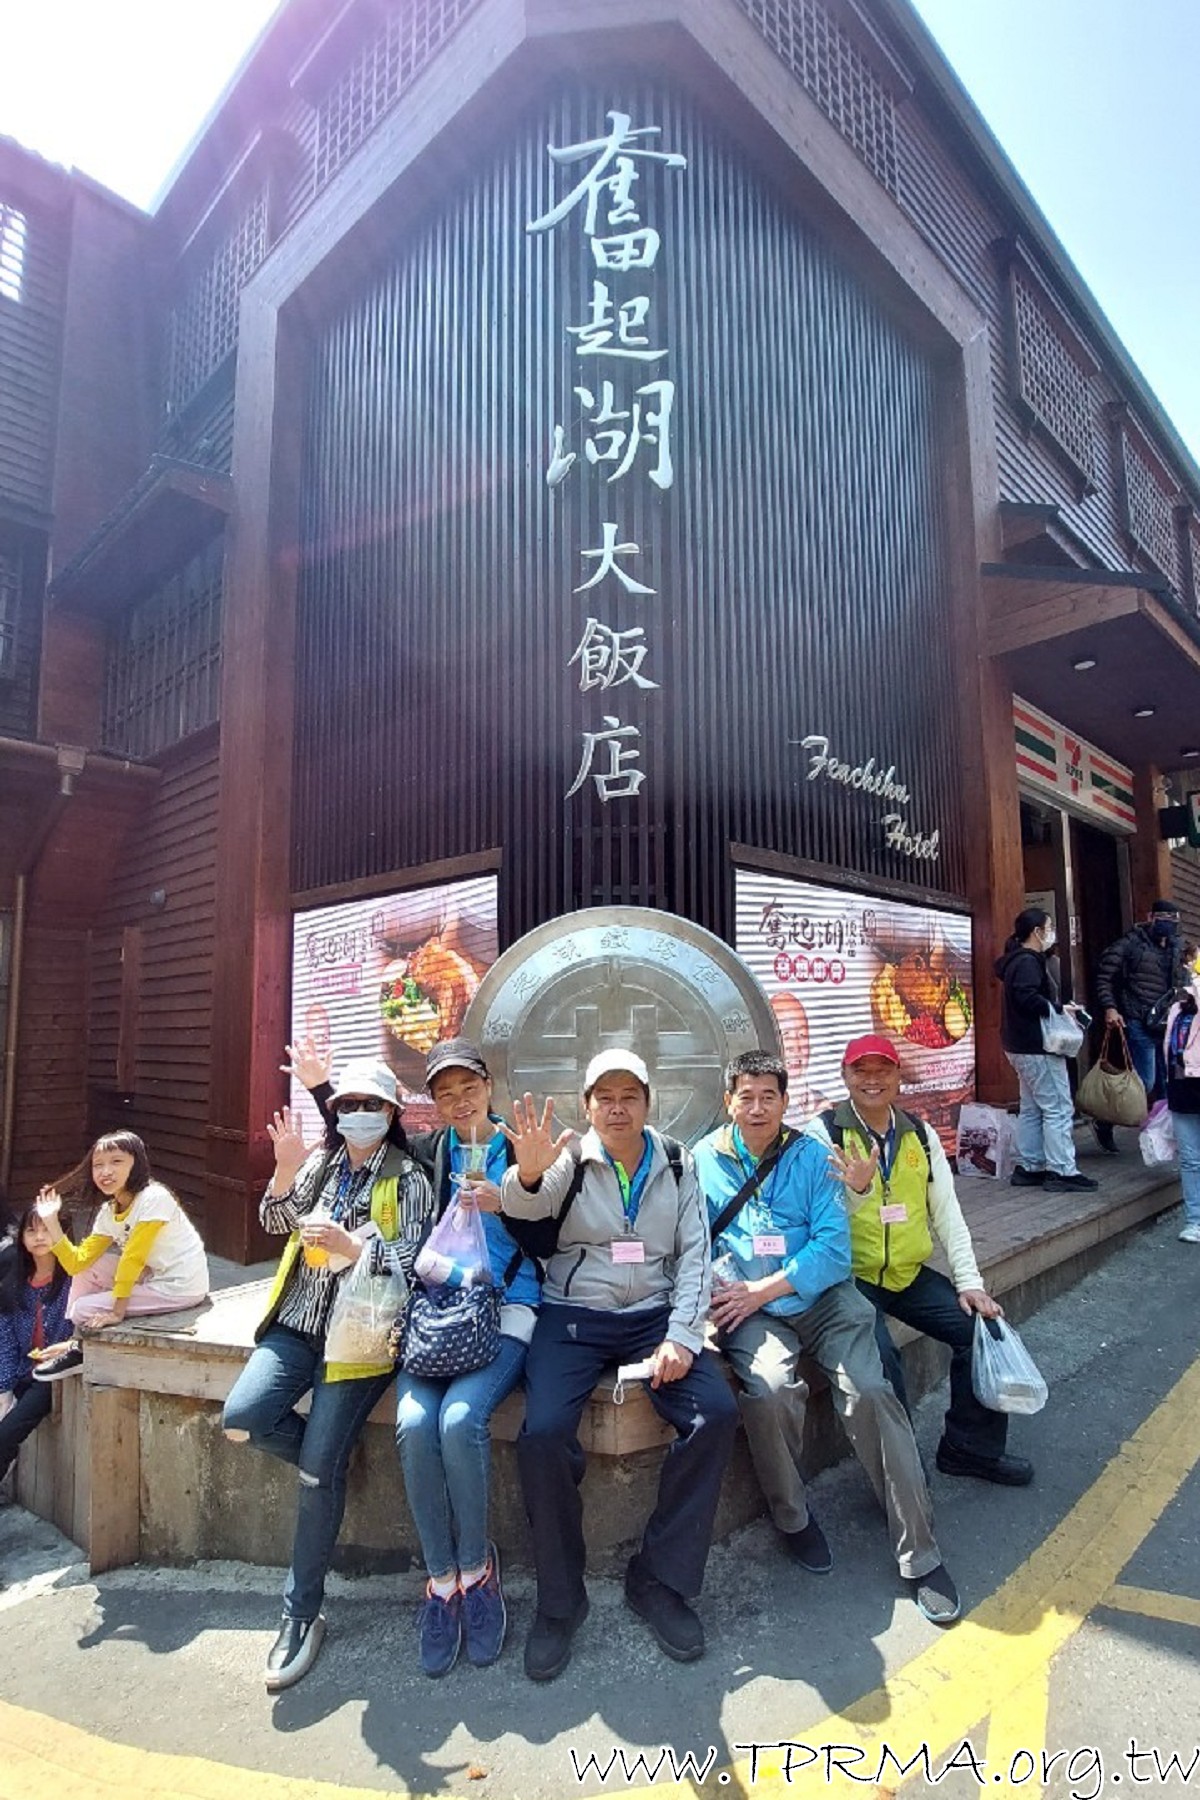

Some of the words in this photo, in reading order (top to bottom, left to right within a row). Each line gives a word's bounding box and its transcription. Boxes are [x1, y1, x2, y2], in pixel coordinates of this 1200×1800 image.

[526, 110, 687, 803] 奮起湖大飯店
[880, 812, 940, 861] Hotel
[759, 896, 844, 953] 奮起湖
